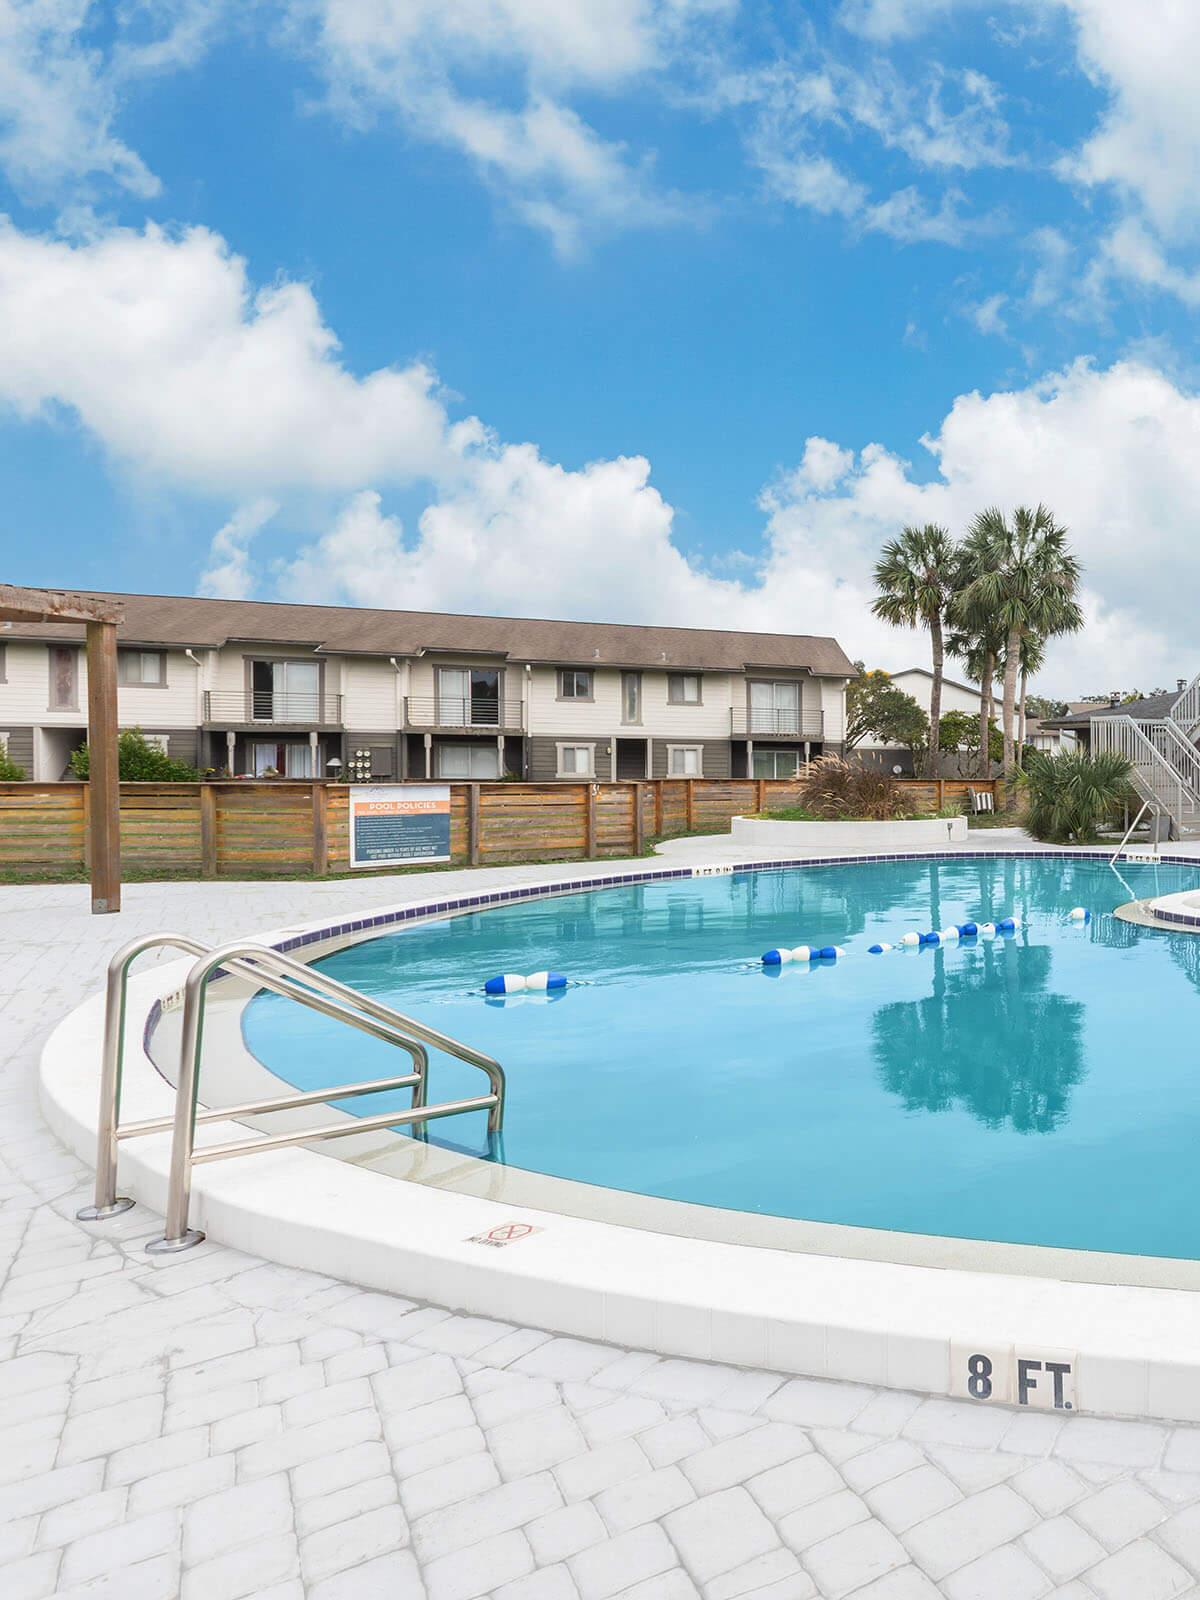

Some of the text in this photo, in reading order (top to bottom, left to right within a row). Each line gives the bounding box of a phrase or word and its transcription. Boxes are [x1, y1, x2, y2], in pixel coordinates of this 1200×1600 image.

[397, 801, 437, 809] POLICIES
[967, 1353, 1073, 1409] 8 FT.
